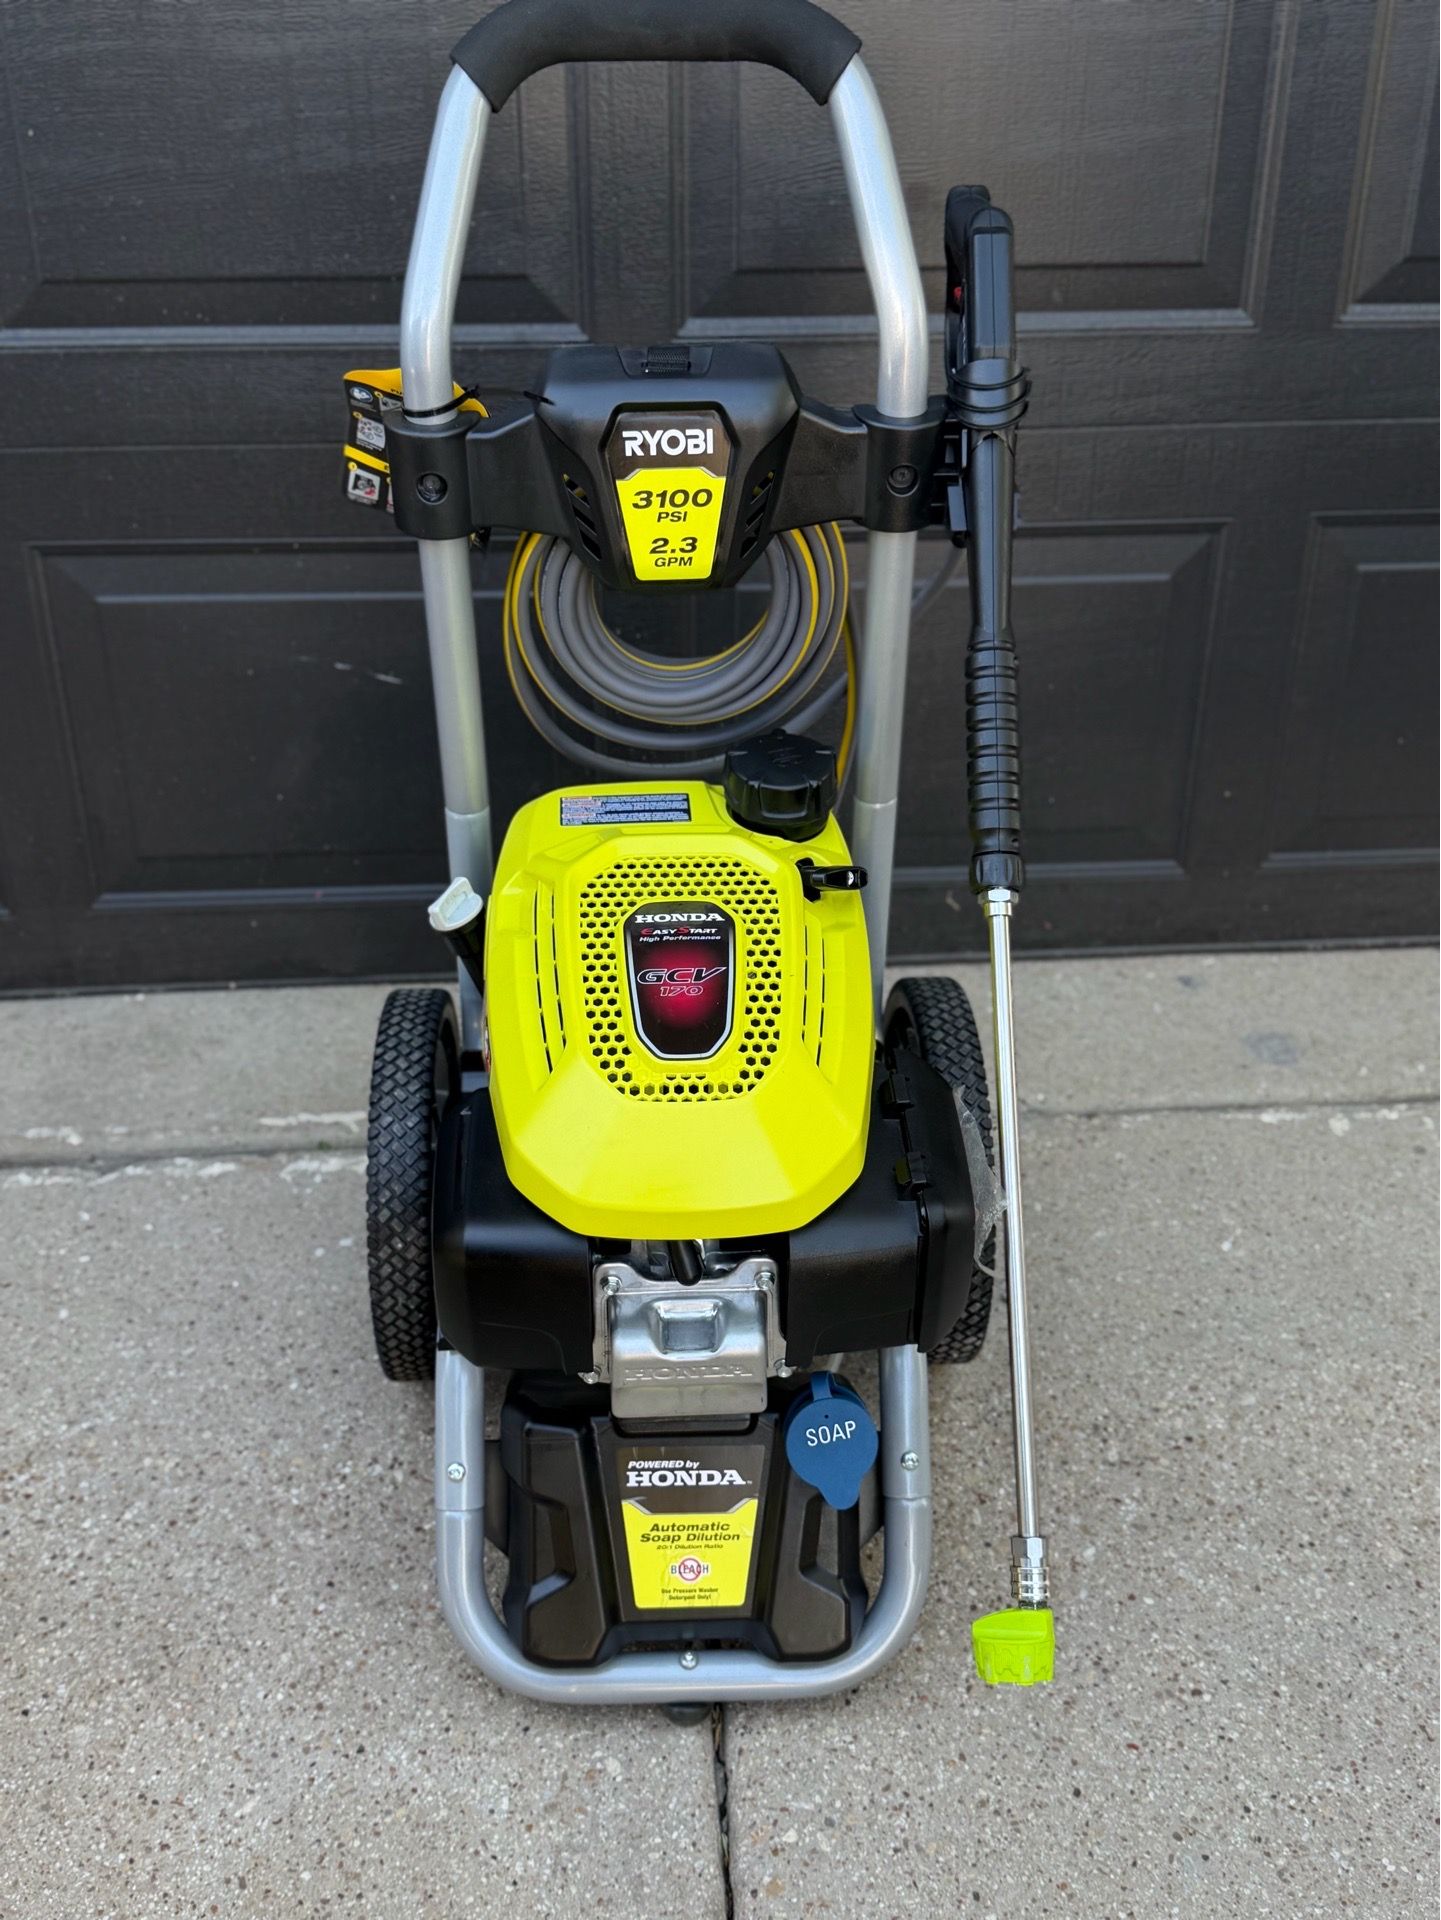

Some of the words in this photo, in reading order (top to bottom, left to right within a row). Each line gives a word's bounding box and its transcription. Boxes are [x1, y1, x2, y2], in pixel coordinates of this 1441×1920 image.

[622, 428, 714, 457] RYOBI
[632, 488, 713, 510] 3100
[657, 511, 688, 523] PSI
[649, 536, 698, 555] 2.3
[654, 557, 693, 568] GPM
[634, 913, 726, 924] HONDA
[639, 935, 660, 943] High
[637, 967, 727, 985] GCV
[660, 985, 703, 997] 170
[625, 1364, 753, 1381] HONDA
[805, 1420, 857, 1447] SOAP
[628, 1460, 684, 1469] POWERED
[685, 1460, 700, 1469] by
[626, 1469, 747, 1487] HONDA
[650, 1522, 730, 1532] Automatic
[640, 1533, 681, 1543] Soap
[686, 1532, 740, 1542] Dilution
[671, 1563, 709, 1574] BLEACH
